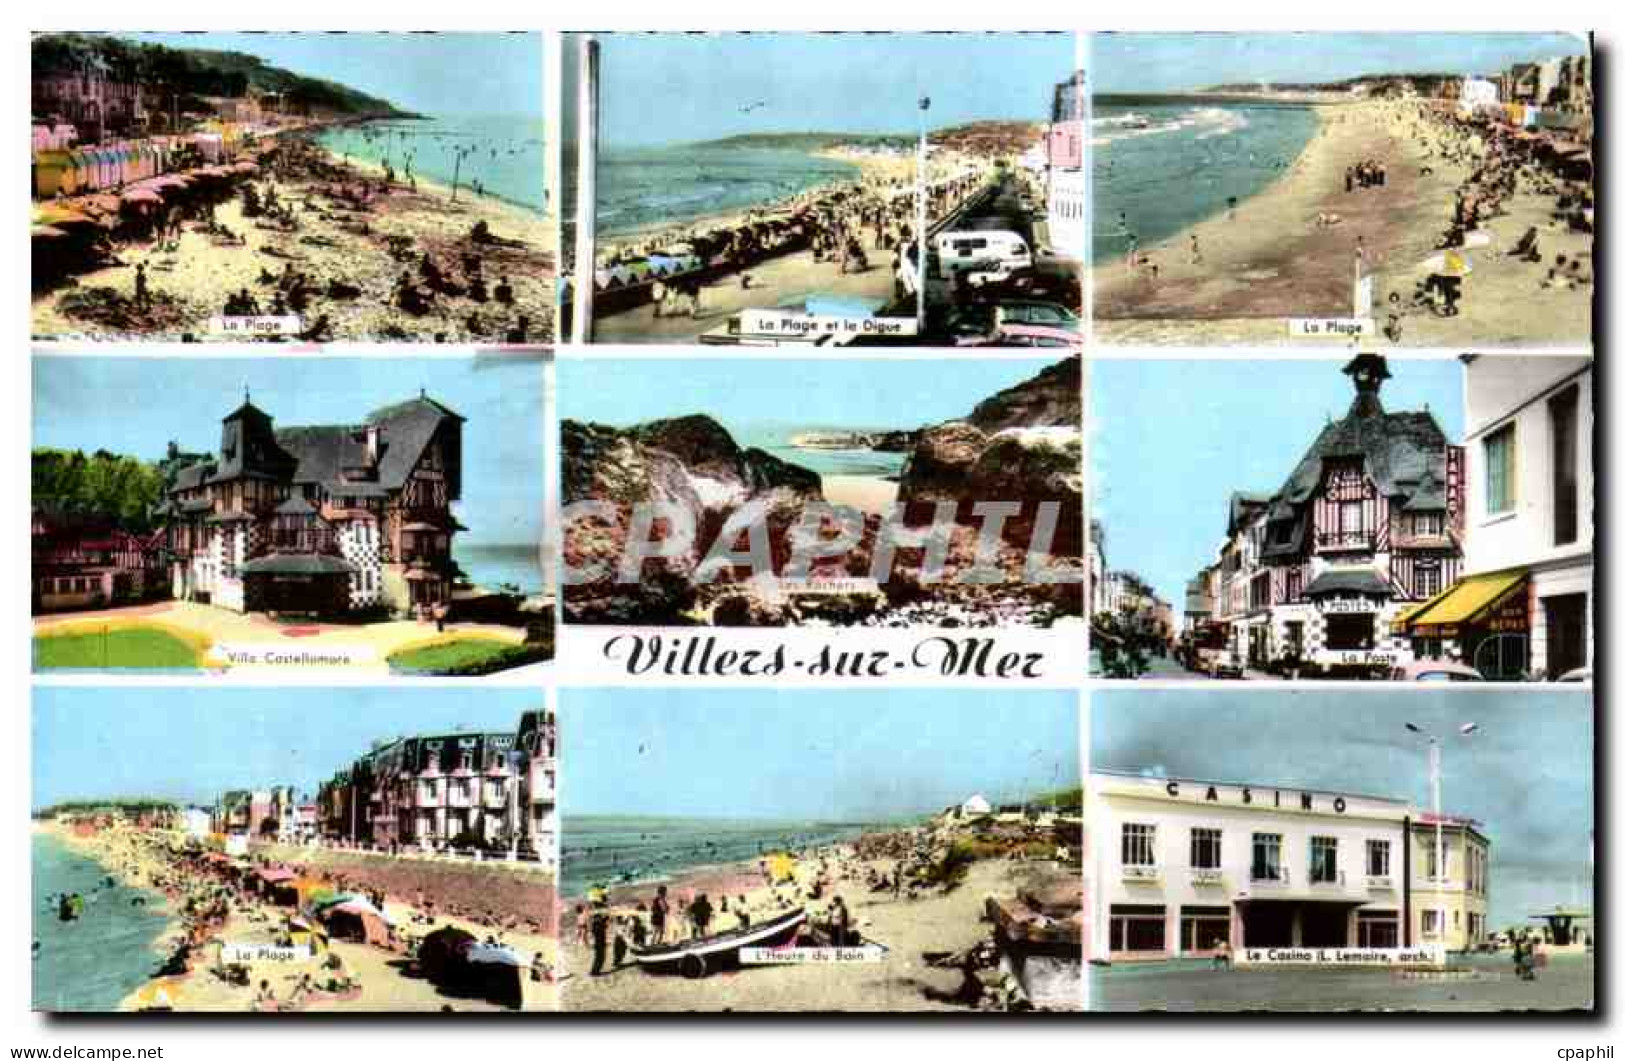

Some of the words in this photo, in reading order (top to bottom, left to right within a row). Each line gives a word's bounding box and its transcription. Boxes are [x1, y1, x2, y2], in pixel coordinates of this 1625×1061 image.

[222, 319, 238, 331] La
[245, 318, 281, 333] Plage
[759, 318, 774, 330] La
[780, 318, 818, 333] Plage
[826, 319, 838, 330] et
[844, 318, 857, 330] la
[863, 318, 901, 333] Digue
[1304, 320, 1319, 333] La
[1326, 320, 1362, 336] Plage
[227, 651, 257, 664] Villa
[603, 635, 1043, 679] Villers-sur-Mer
[1341, 652, 1357, 663] La
[1365, 652, 1397, 664] Poste
[1166, 782, 1346, 813] CASINO
[236, 949, 251, 961] La
[258, 949, 295, 963] Plage
[756, 948, 805, 960] L'Heure
[813, 949, 829, 960] du
[836, 948, 864, 960] Bain
[1248, 949, 1261, 961] Le
[1267, 949, 1312, 961] Casino
